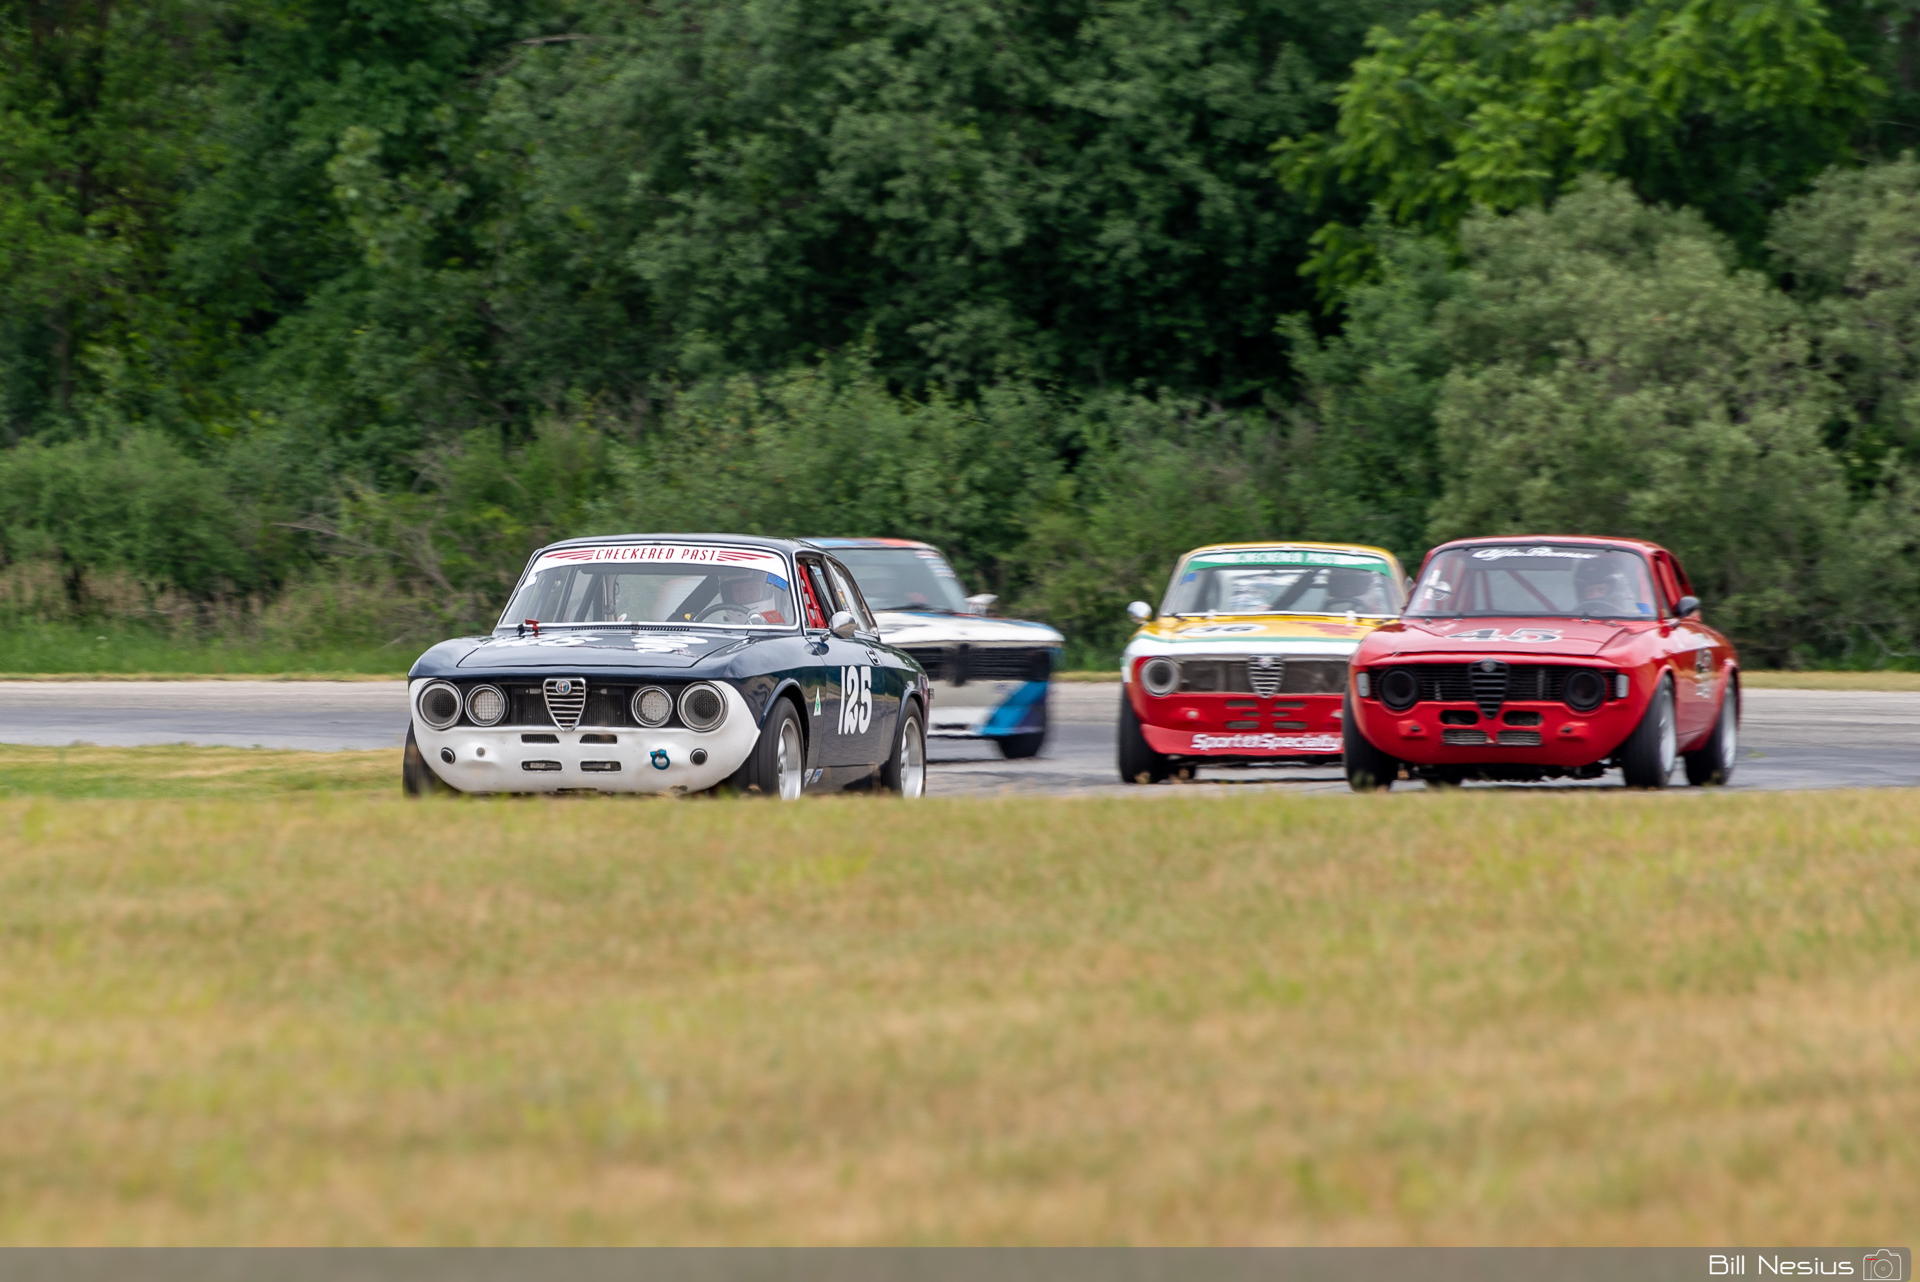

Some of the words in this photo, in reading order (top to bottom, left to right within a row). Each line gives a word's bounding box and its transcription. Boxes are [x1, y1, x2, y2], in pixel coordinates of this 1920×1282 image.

[595, 547, 675, 560] CHECKERED
[681, 549, 717, 561] PAST
[1445, 627, 1565, 643] 45
[837, 665, 873, 735] 125
